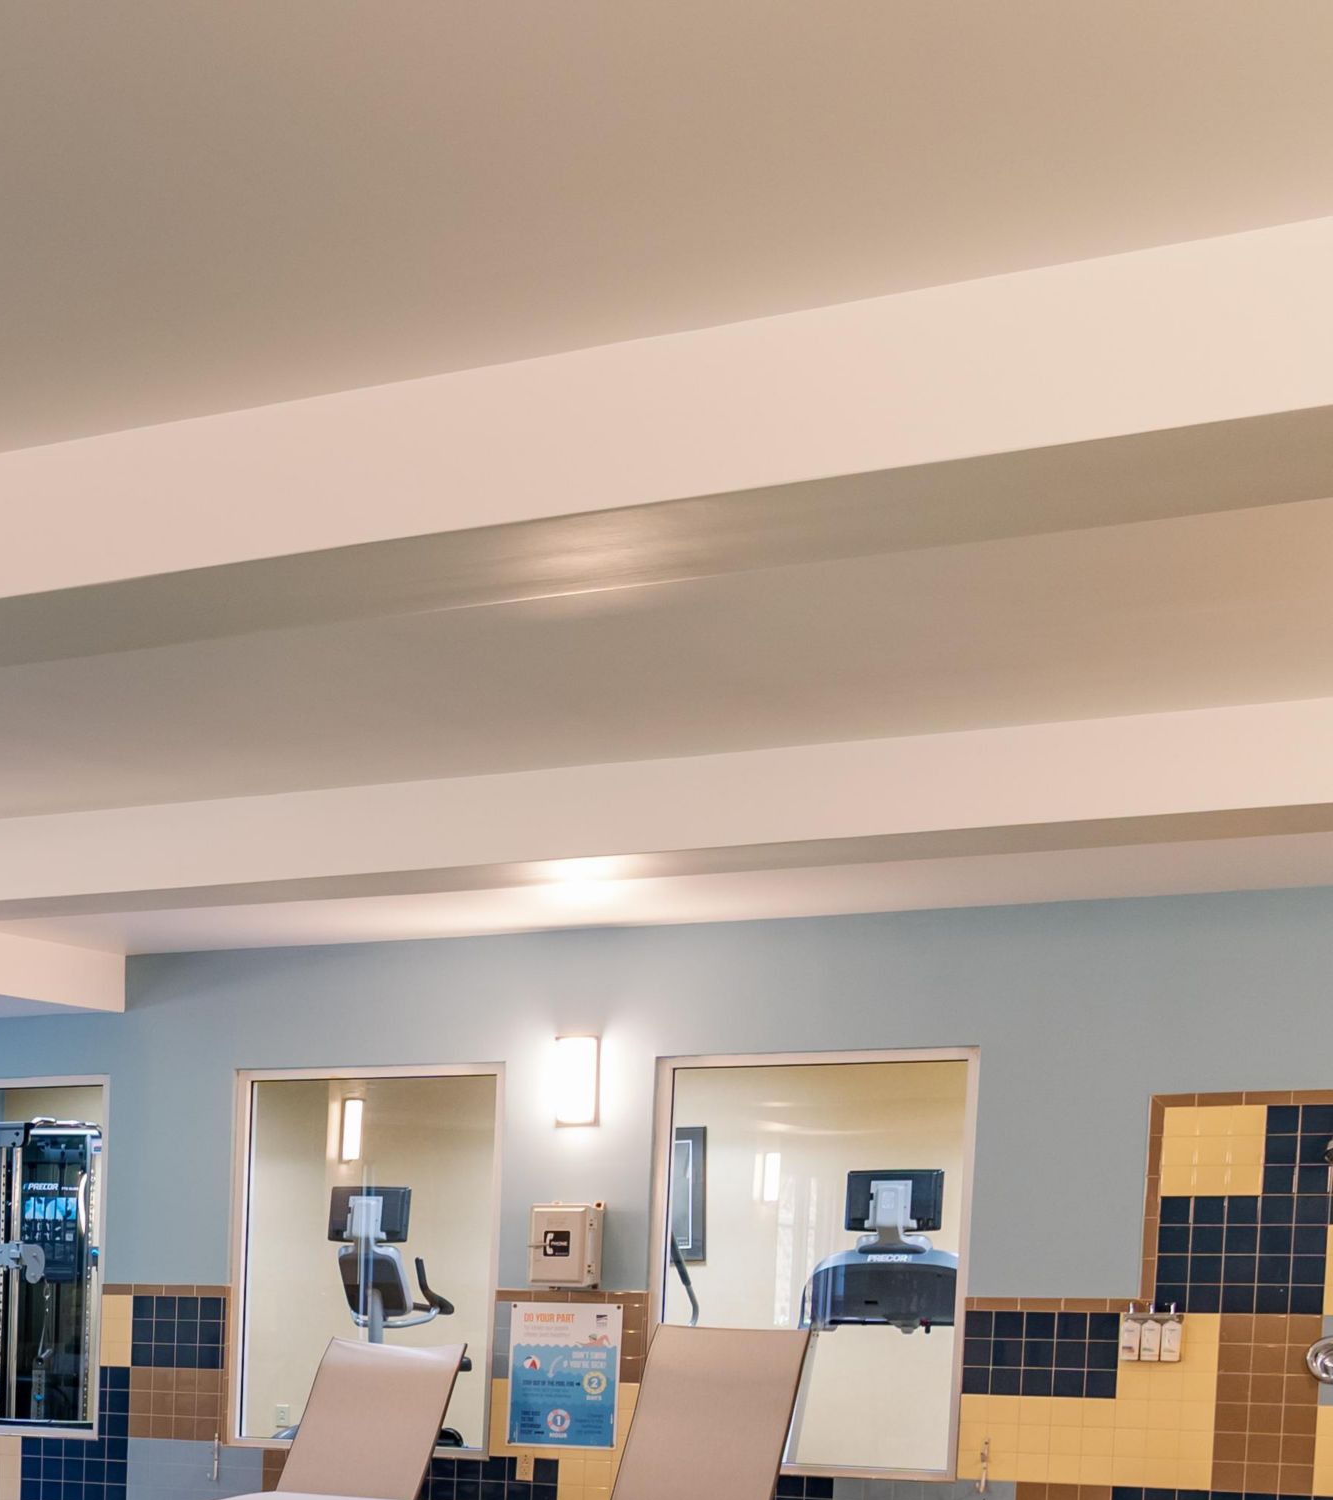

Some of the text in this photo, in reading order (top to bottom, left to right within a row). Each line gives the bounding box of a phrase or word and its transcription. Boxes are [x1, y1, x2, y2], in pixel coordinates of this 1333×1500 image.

[28, 1183, 58, 1191] PRECOR
[867, 1254, 907, 1262] PRECOR
[591, 1378, 598, 1388] 2
[556, 1416, 561, 1426] 1
